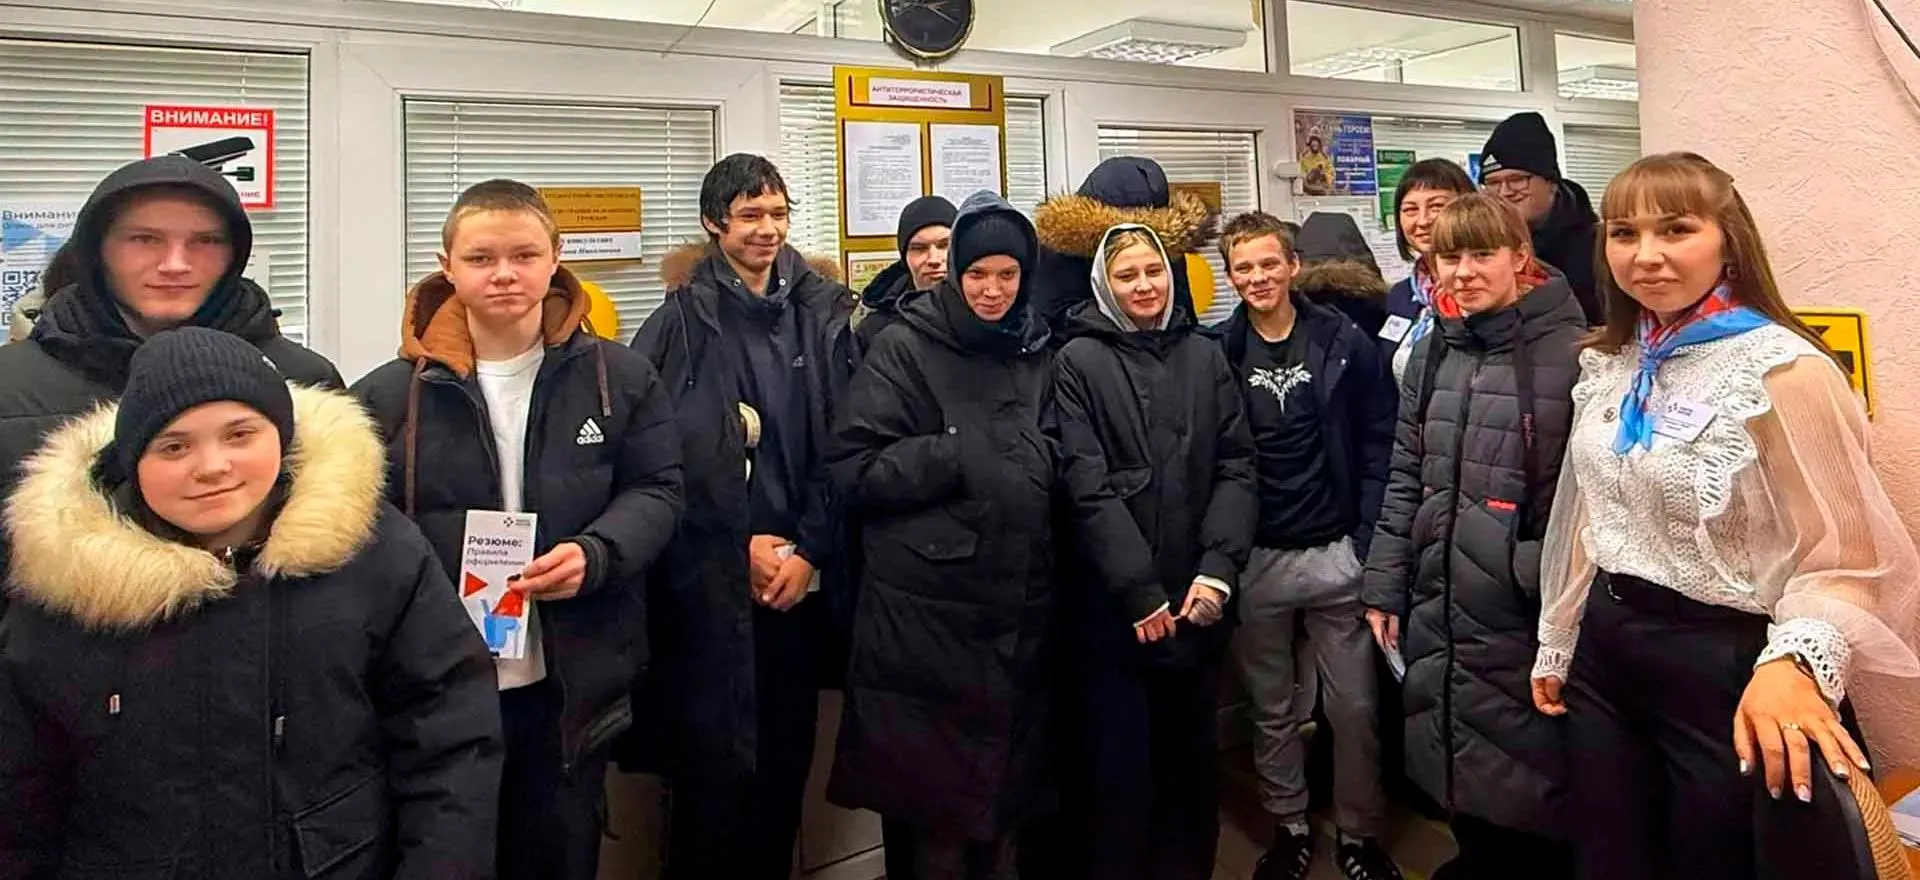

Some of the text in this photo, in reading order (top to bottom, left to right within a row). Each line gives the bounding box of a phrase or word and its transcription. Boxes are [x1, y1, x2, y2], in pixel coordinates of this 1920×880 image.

[151, 109, 268, 126] ВНИМАНИЕ!
[3, 210, 76, 221] Внимани
[576, 433, 605, 445] adidas
[468, 535, 523, 548] Резюме:
[466, 547, 509, 556] Правила
